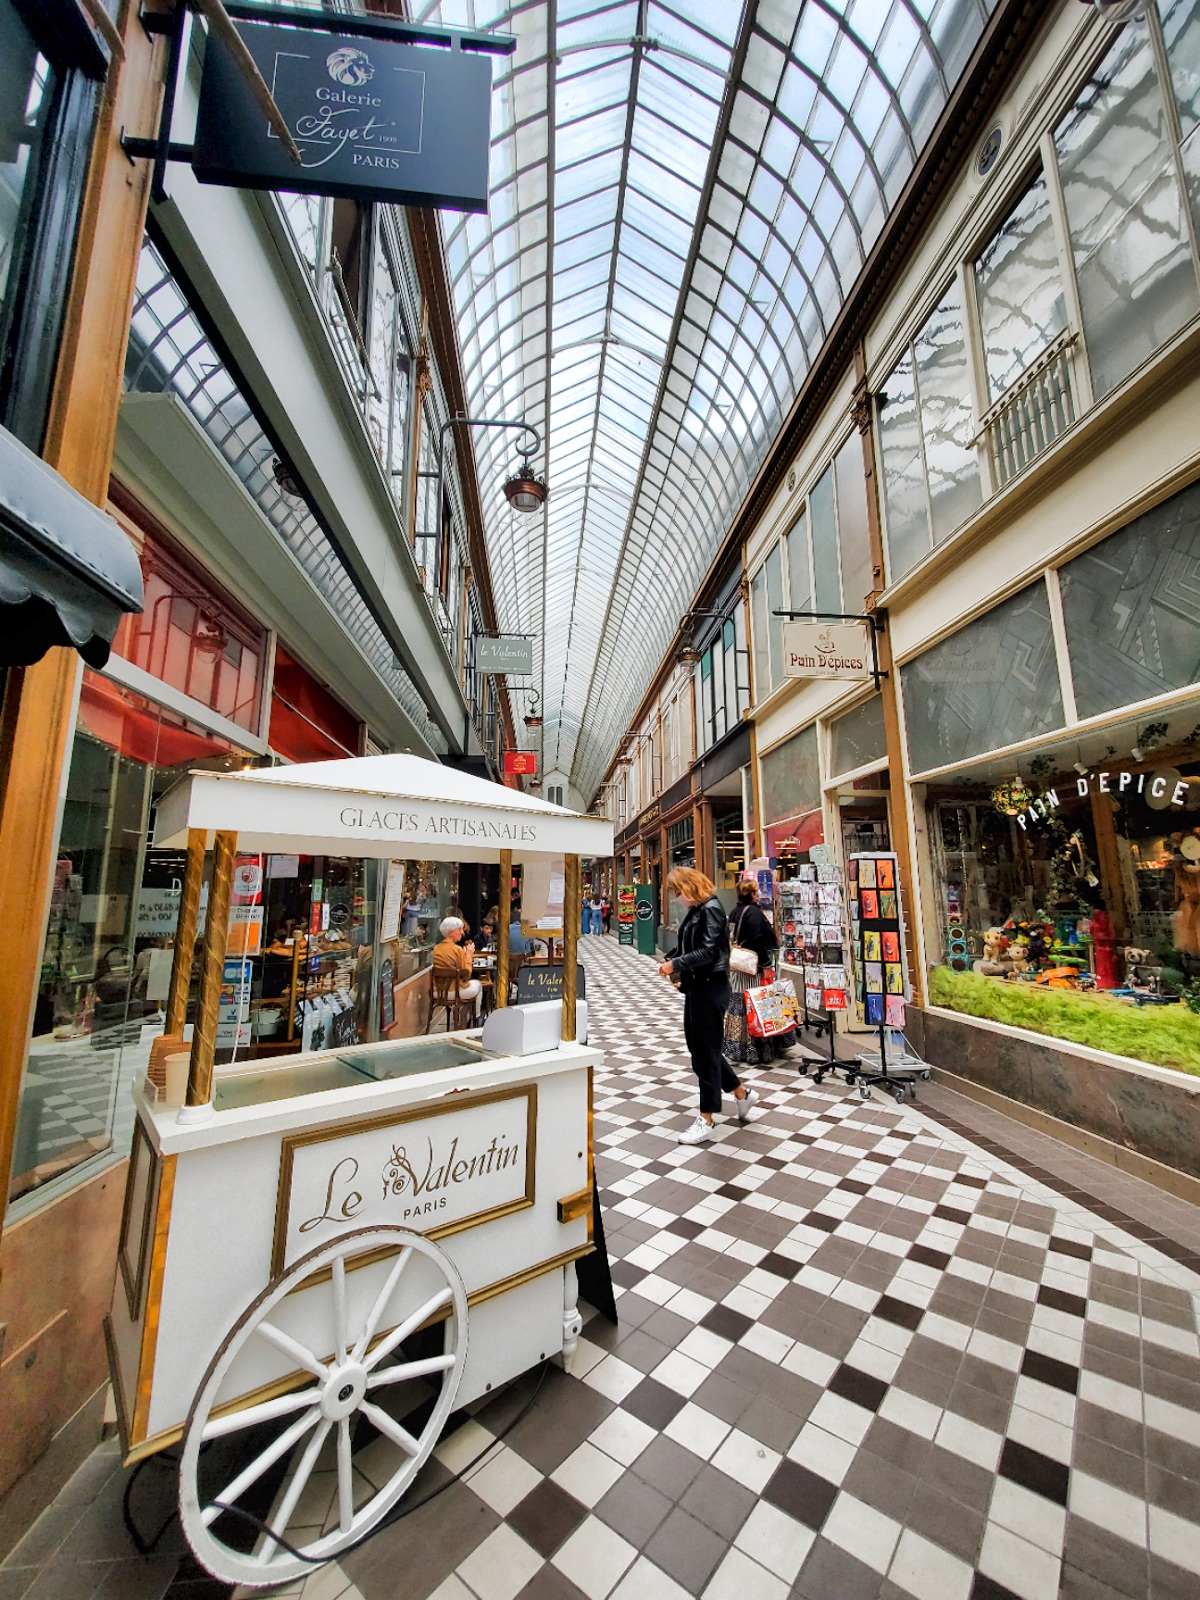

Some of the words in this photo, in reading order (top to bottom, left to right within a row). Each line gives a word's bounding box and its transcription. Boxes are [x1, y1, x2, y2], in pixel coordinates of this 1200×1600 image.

[316, 87, 382, 107] Galerie
[296, 106, 388, 168] Fayet
[352, 153, 400, 169] PARIS
[491, 645, 528, 658] Valentin
[790, 652, 816, 667] Pain
[1016, 788, 1060, 831] PAIN
[1076, 772, 1190, 806] D'EPICE
[339, 807, 419, 832] GLACES
[425, 815, 537, 842] ARTISANALES
[299, 1157, 367, 1233] Le
[382, 1134, 520, 1200] Valentin
[403, 1198, 448, 1220] PARIS
